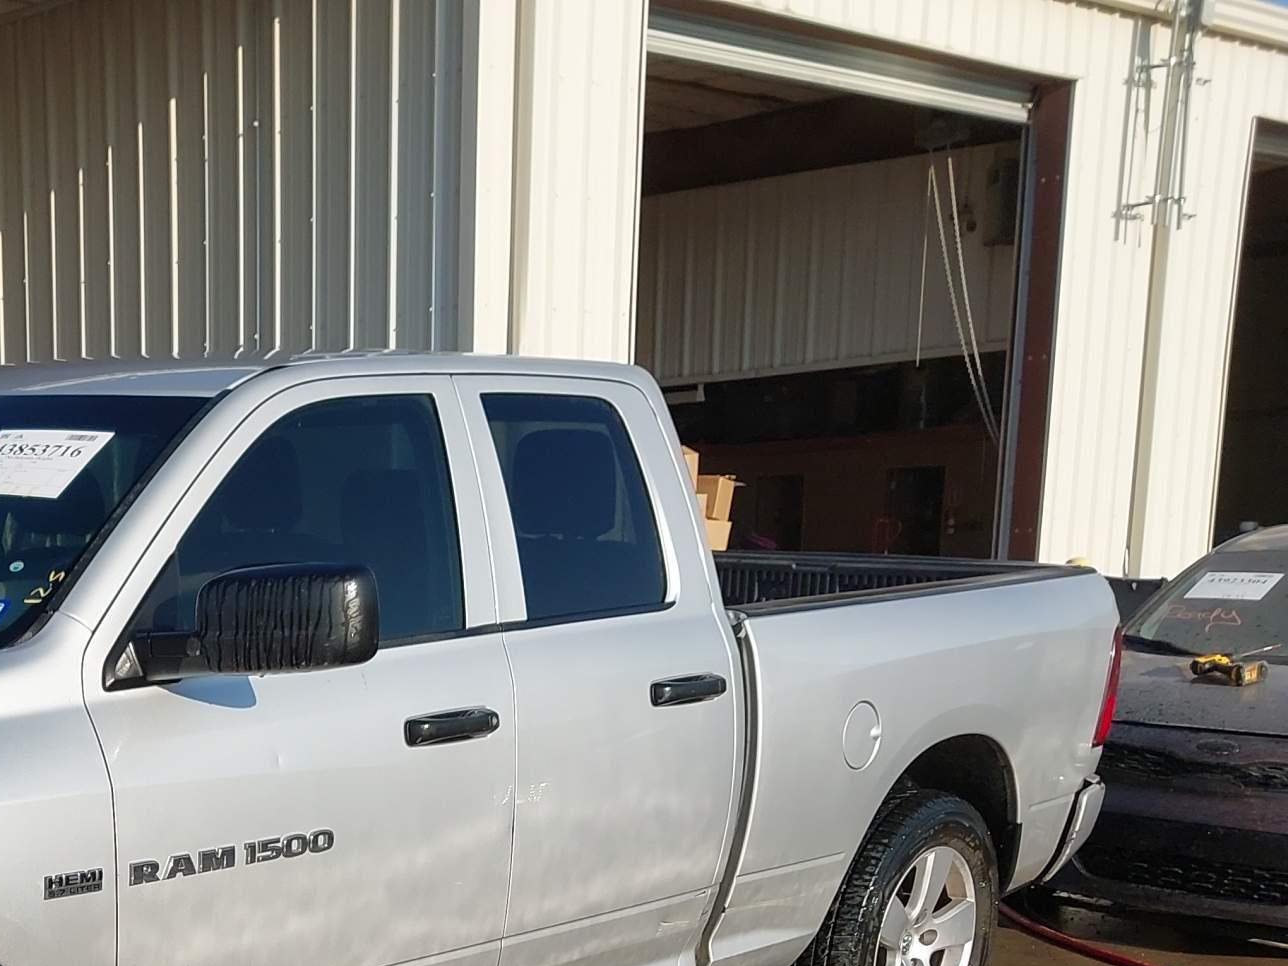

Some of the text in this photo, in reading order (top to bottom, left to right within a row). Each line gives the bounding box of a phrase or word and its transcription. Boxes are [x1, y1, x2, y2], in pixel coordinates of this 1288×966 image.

[128, 828, 335, 887] RAM 1500
[44, 867, 103, 890] HEMI
